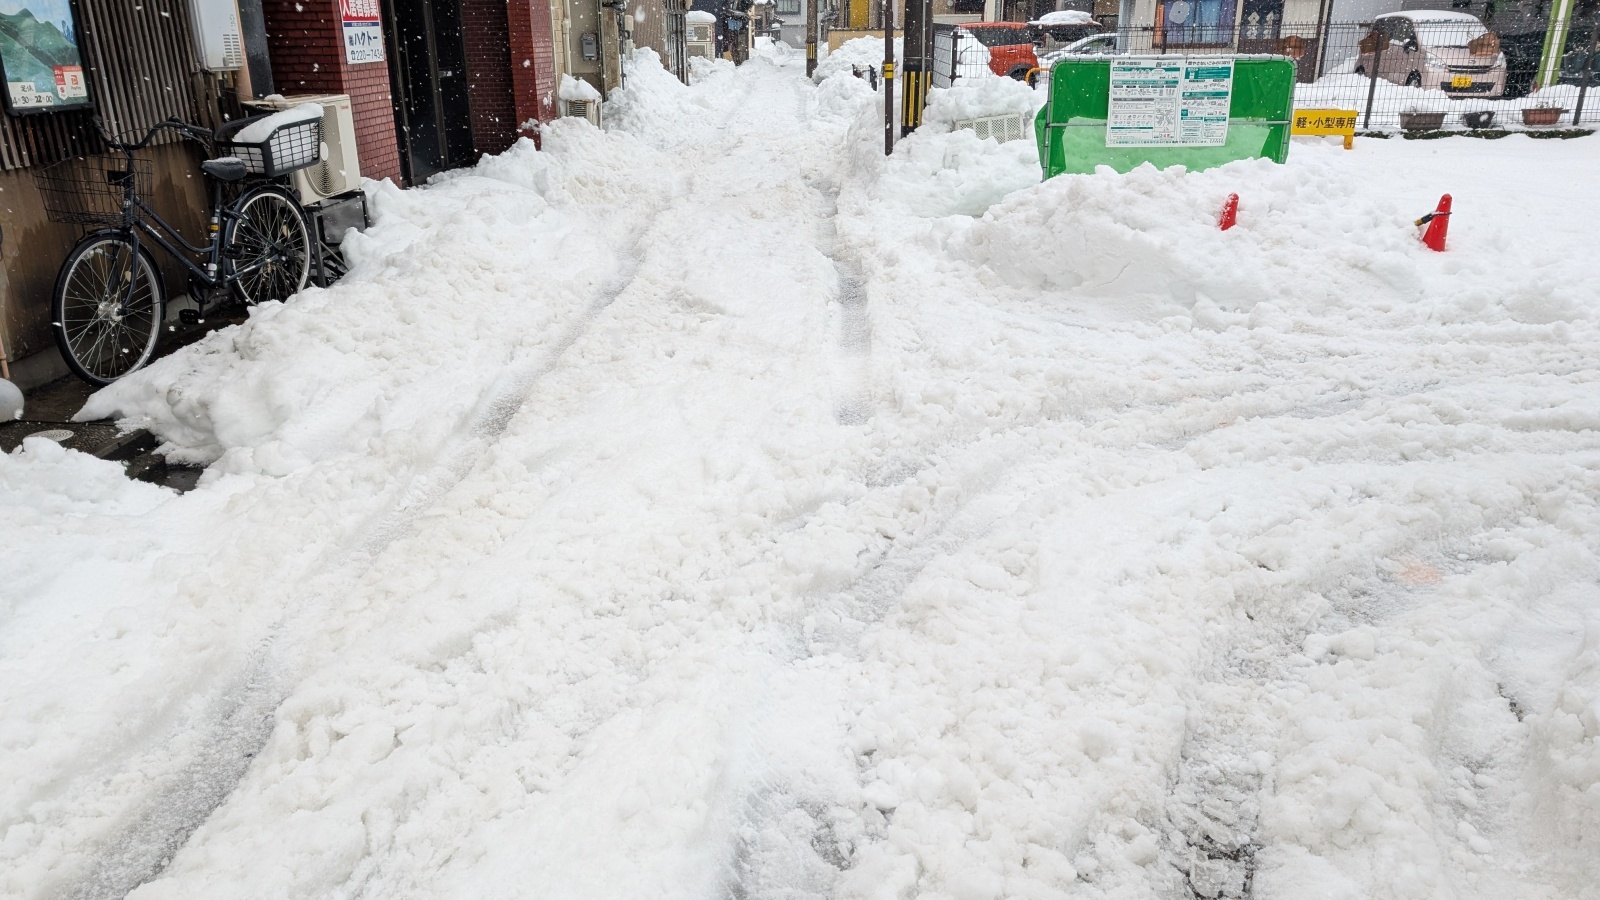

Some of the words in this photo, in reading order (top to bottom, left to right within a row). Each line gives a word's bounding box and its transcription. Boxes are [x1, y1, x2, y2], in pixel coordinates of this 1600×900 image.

[1295, 116, 1357, 129] 軽・小型専用
